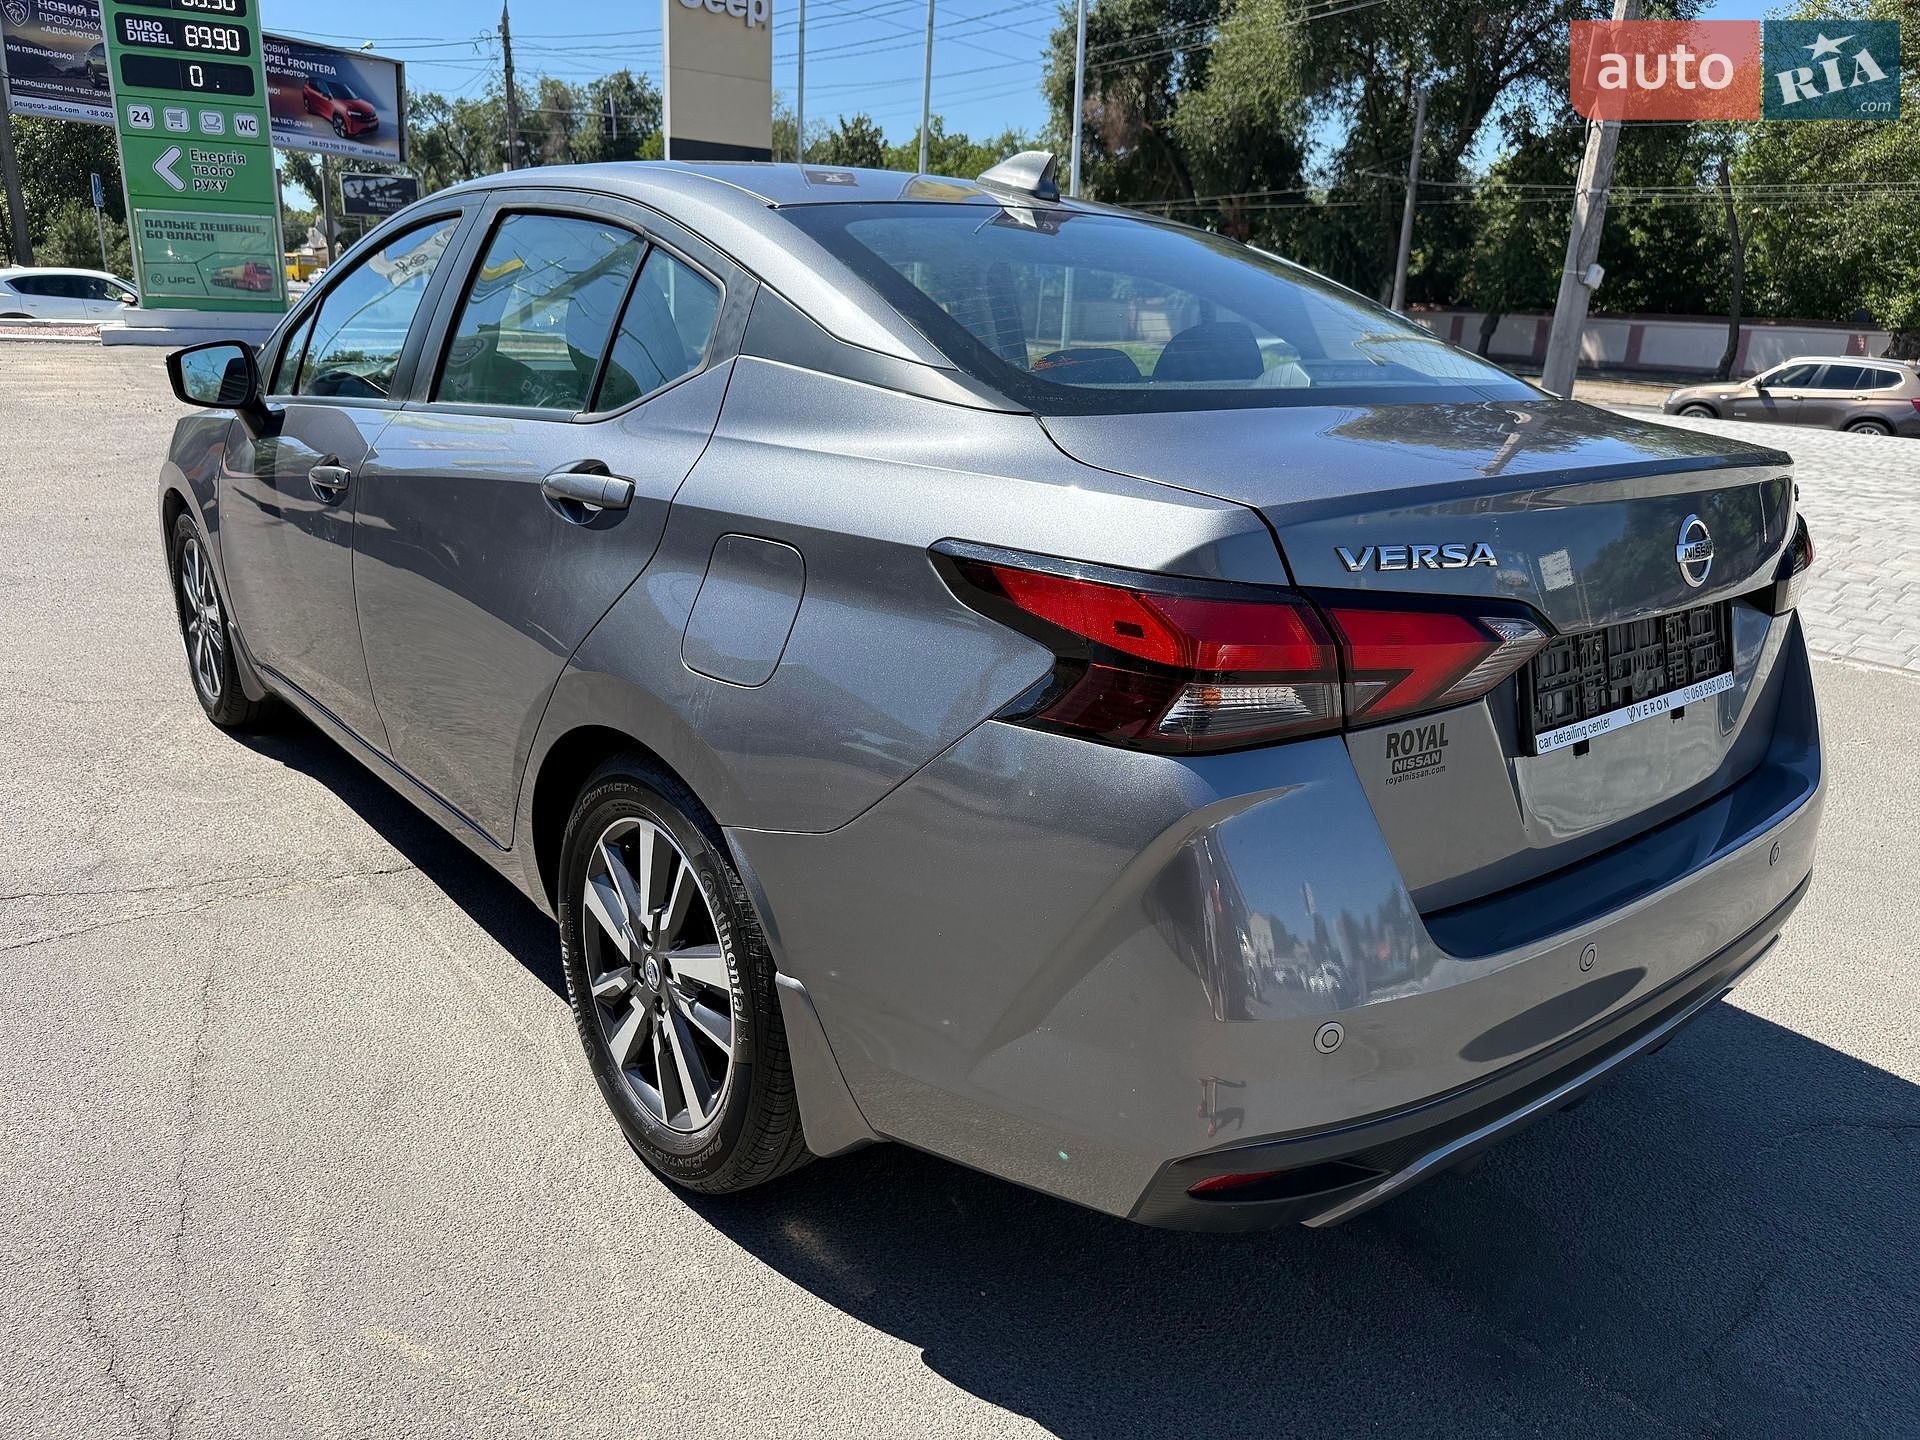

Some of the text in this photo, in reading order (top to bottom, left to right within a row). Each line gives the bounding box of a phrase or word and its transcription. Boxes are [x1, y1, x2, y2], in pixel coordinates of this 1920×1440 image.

[37, 0, 87, 17] НОВИЙ
[680, 0, 771, 28] eep
[39, 12, 103, 30] ПРОБУДЖУ
[125, 19, 163, 32] EURO
[41, 25, 104, 41] «АДІС-МОТОР
[127, 30, 174, 45] DIESEL
[7, 44, 21, 52] МИ
[263, 53, 337, 76] OPEL FRONTERA
[265, 65, 309, 78] АДІС-МОТОР»
[189, 65, 204, 87] 0
[131, 110, 151, 123] 24
[237, 119, 257, 132] WC
[190, 149, 246, 166] Енергія
[192, 165, 235, 178] твого
[193, 179, 228, 192] руху
[144, 219, 197, 231] ПАЛЬНЕ
[146, 230, 164, 240] БО
[1335, 542, 1498, 573] VERSA
[1538, 737, 1552, 749] car
[1553, 724, 1587, 745] detailing
[1588, 717, 1611, 733] center
[1636, 698, 1670, 718] VERON
[1386, 723, 1448, 758] ROYAL
[1393, 750, 1441, 772] NISSAN
[1385, 765, 1446, 785] royalnissan.com
